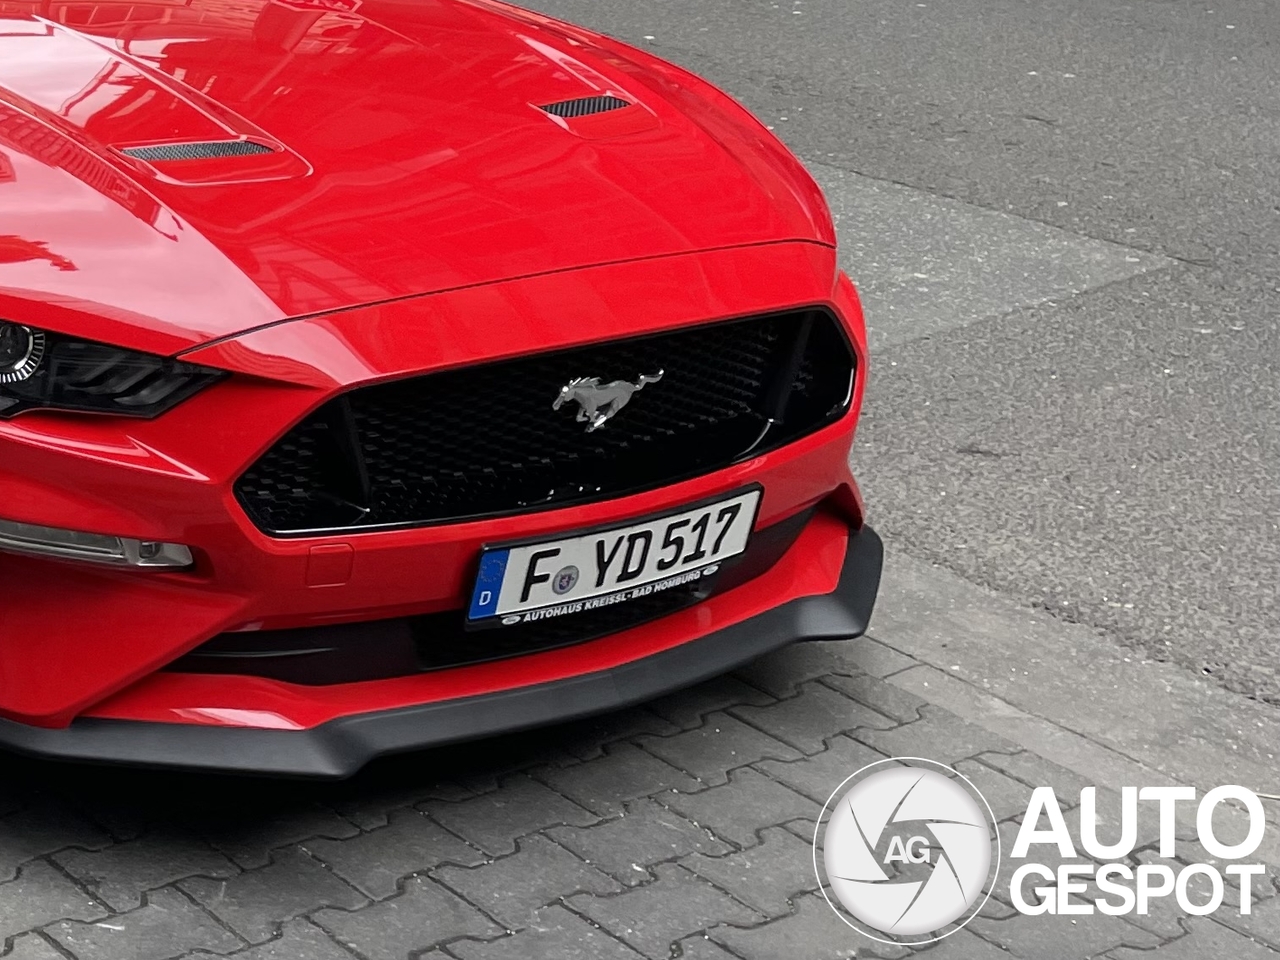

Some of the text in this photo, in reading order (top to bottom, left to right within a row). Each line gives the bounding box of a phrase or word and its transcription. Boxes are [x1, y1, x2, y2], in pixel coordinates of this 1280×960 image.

[519, 502, 742, 603] F YD 517
[478, 591, 491, 605] D
[523, 602, 583, 622] AUTOHAUS
[654, 570, 701, 592] HOMBURG
